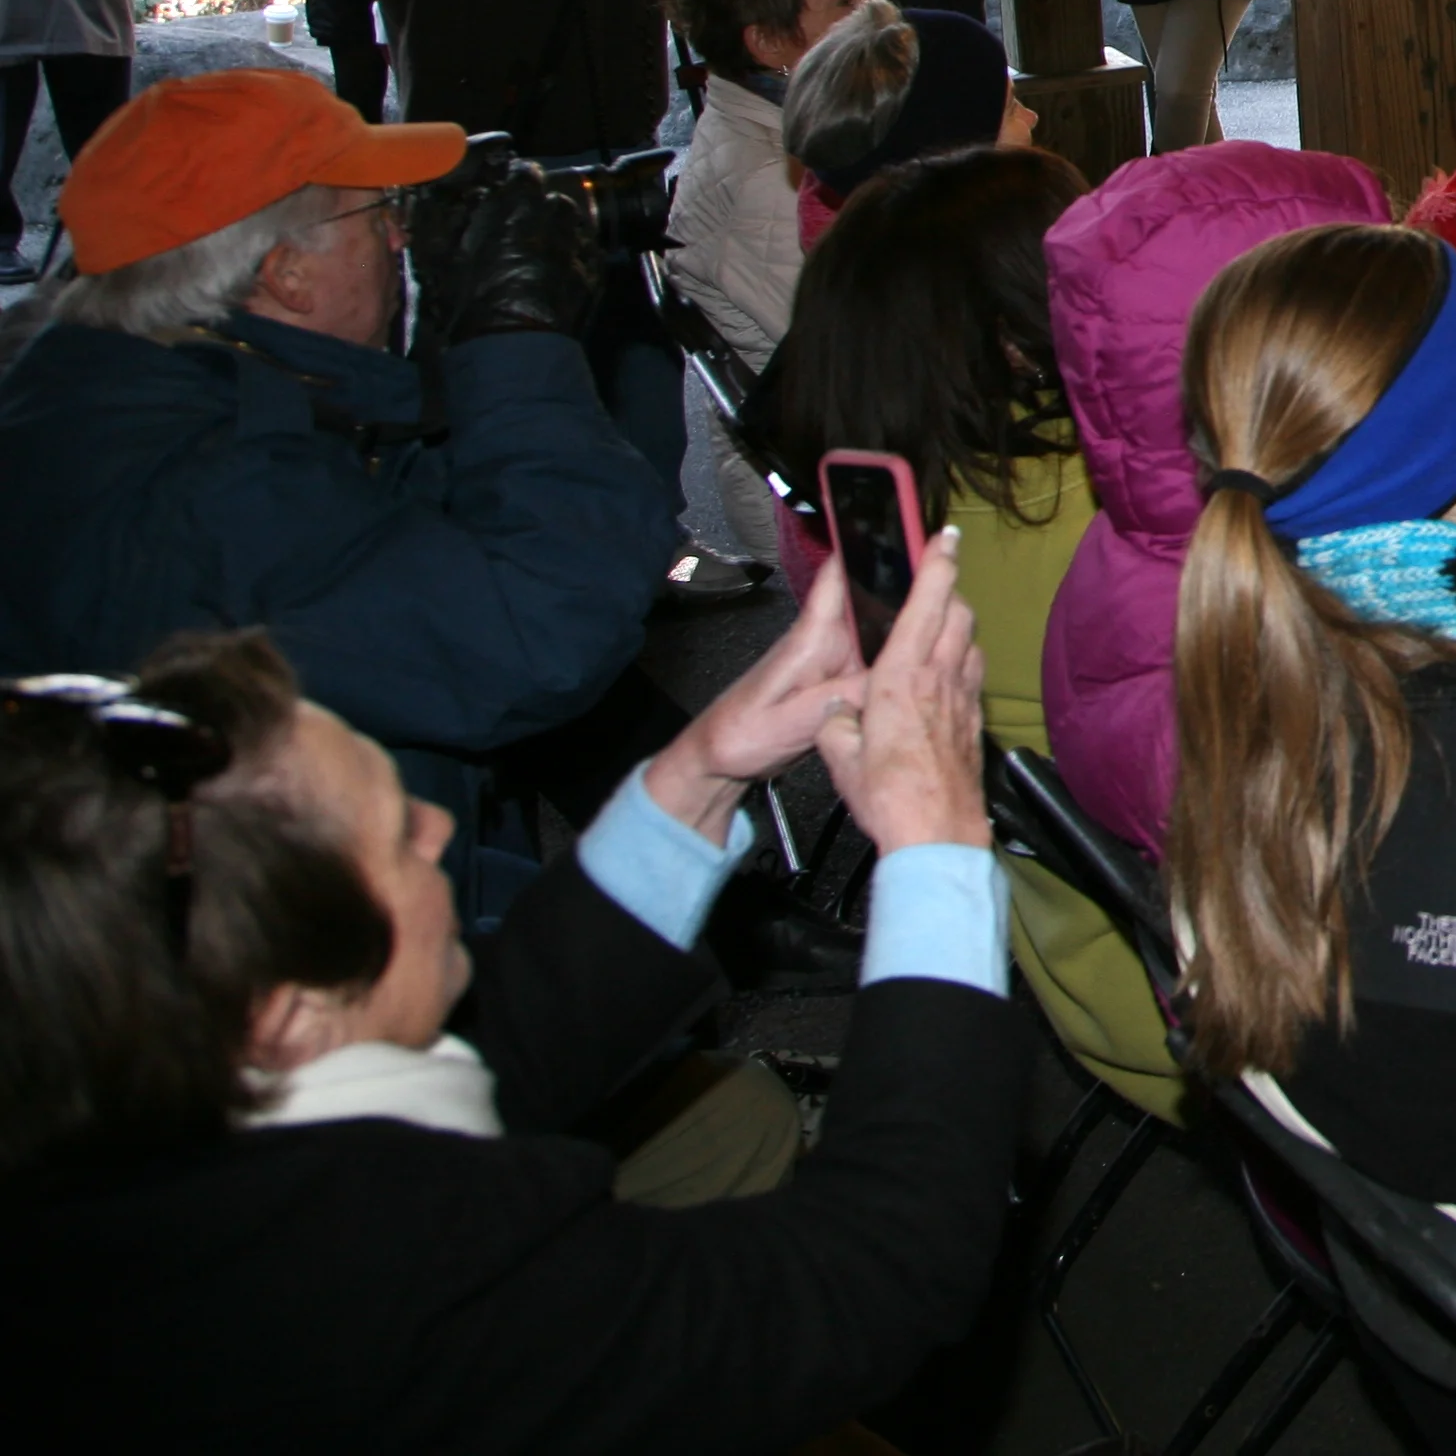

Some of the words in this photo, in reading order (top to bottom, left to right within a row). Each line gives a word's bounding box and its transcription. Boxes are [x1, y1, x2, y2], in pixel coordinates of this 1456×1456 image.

[1417, 911, 1451, 934] THE
[1392, 924, 1451, 950] NORTH
[1407, 944, 1453, 966] FACE
